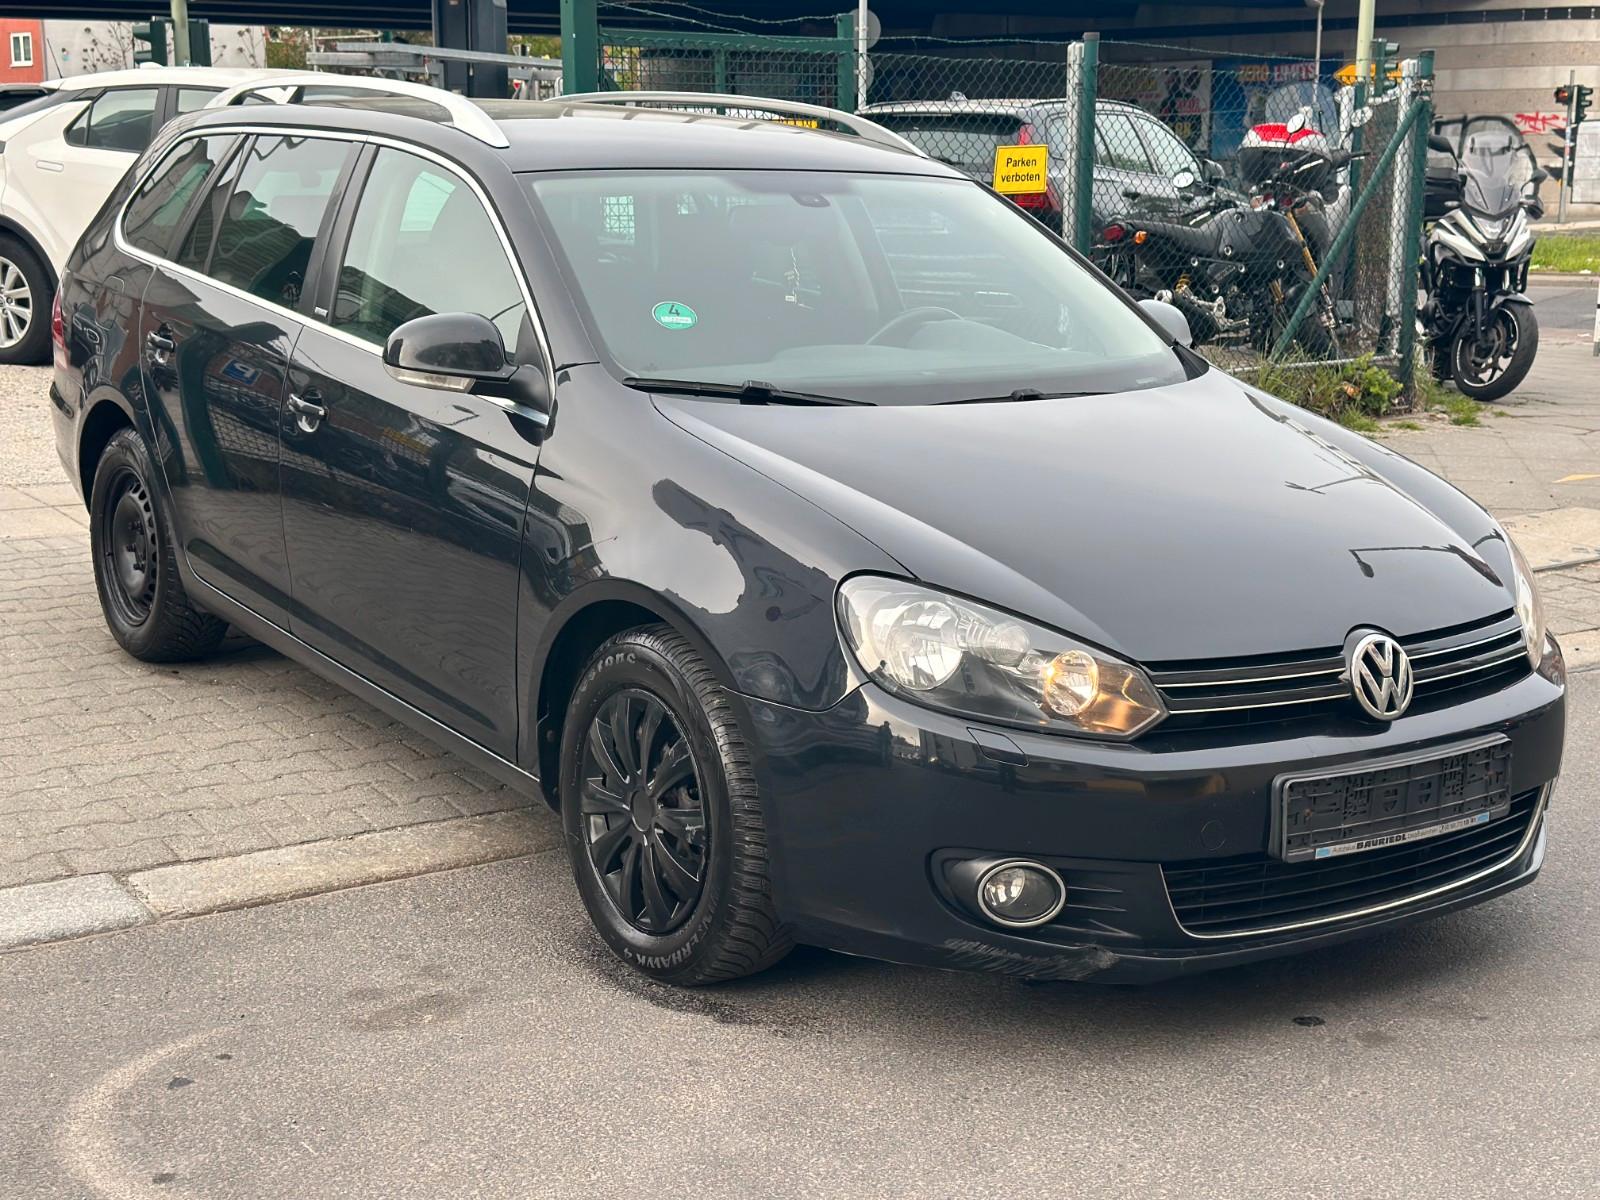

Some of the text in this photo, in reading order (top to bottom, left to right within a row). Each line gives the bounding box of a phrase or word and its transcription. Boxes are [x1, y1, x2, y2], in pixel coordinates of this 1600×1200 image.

[1006, 157, 1037, 168] Parken
[1001, 172, 1040, 183] verboten
[668, 304, 680, 317] 4
[1356, 833, 1407, 849] BAURIEDL
